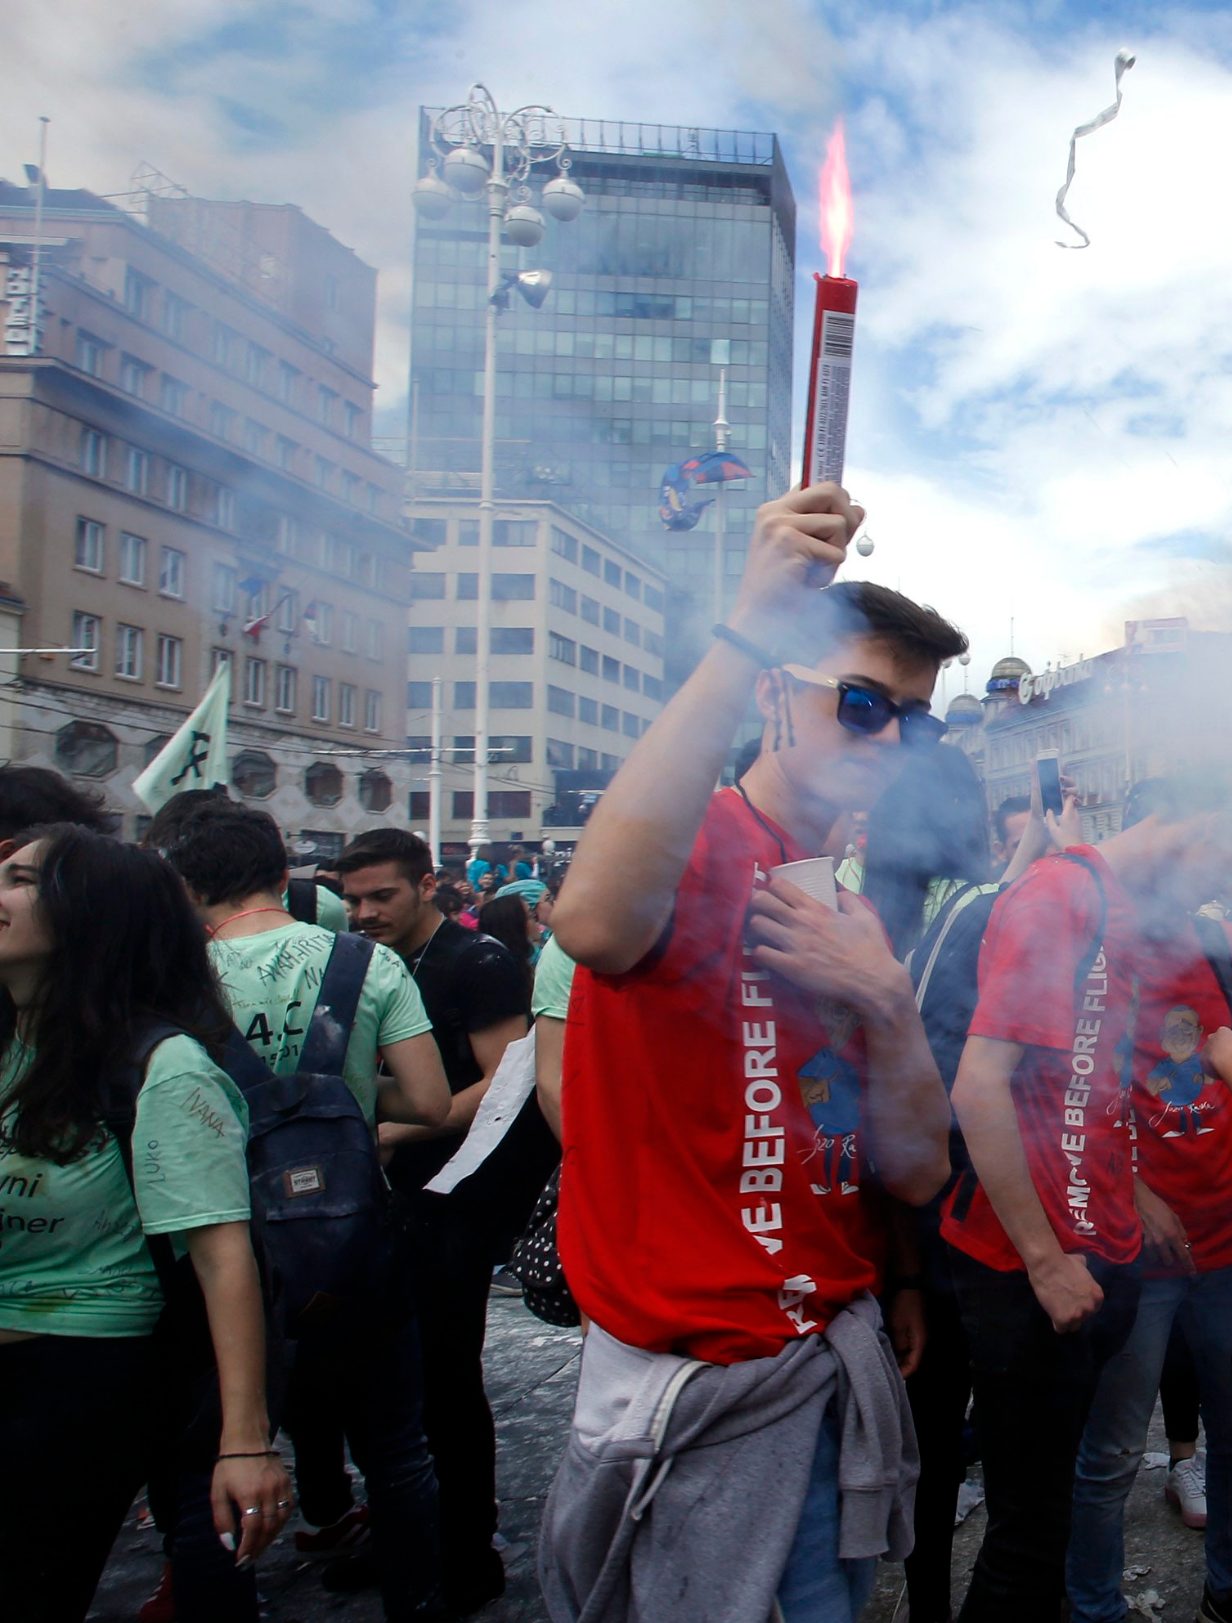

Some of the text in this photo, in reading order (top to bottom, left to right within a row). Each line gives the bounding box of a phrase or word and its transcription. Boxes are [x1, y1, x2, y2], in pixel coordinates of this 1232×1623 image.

[245, 1000, 304, 1046] 4.C
[1064, 1018, 1101, 1127] BEFORE
[1083, 946, 1109, 1012] FLIG
[180, 1086, 226, 1140] IVANA
[739, 1020, 785, 1195] BEFORE
[840, 1134, 857, 1160] Ra
[741, 1201, 818, 1335] REMVE
